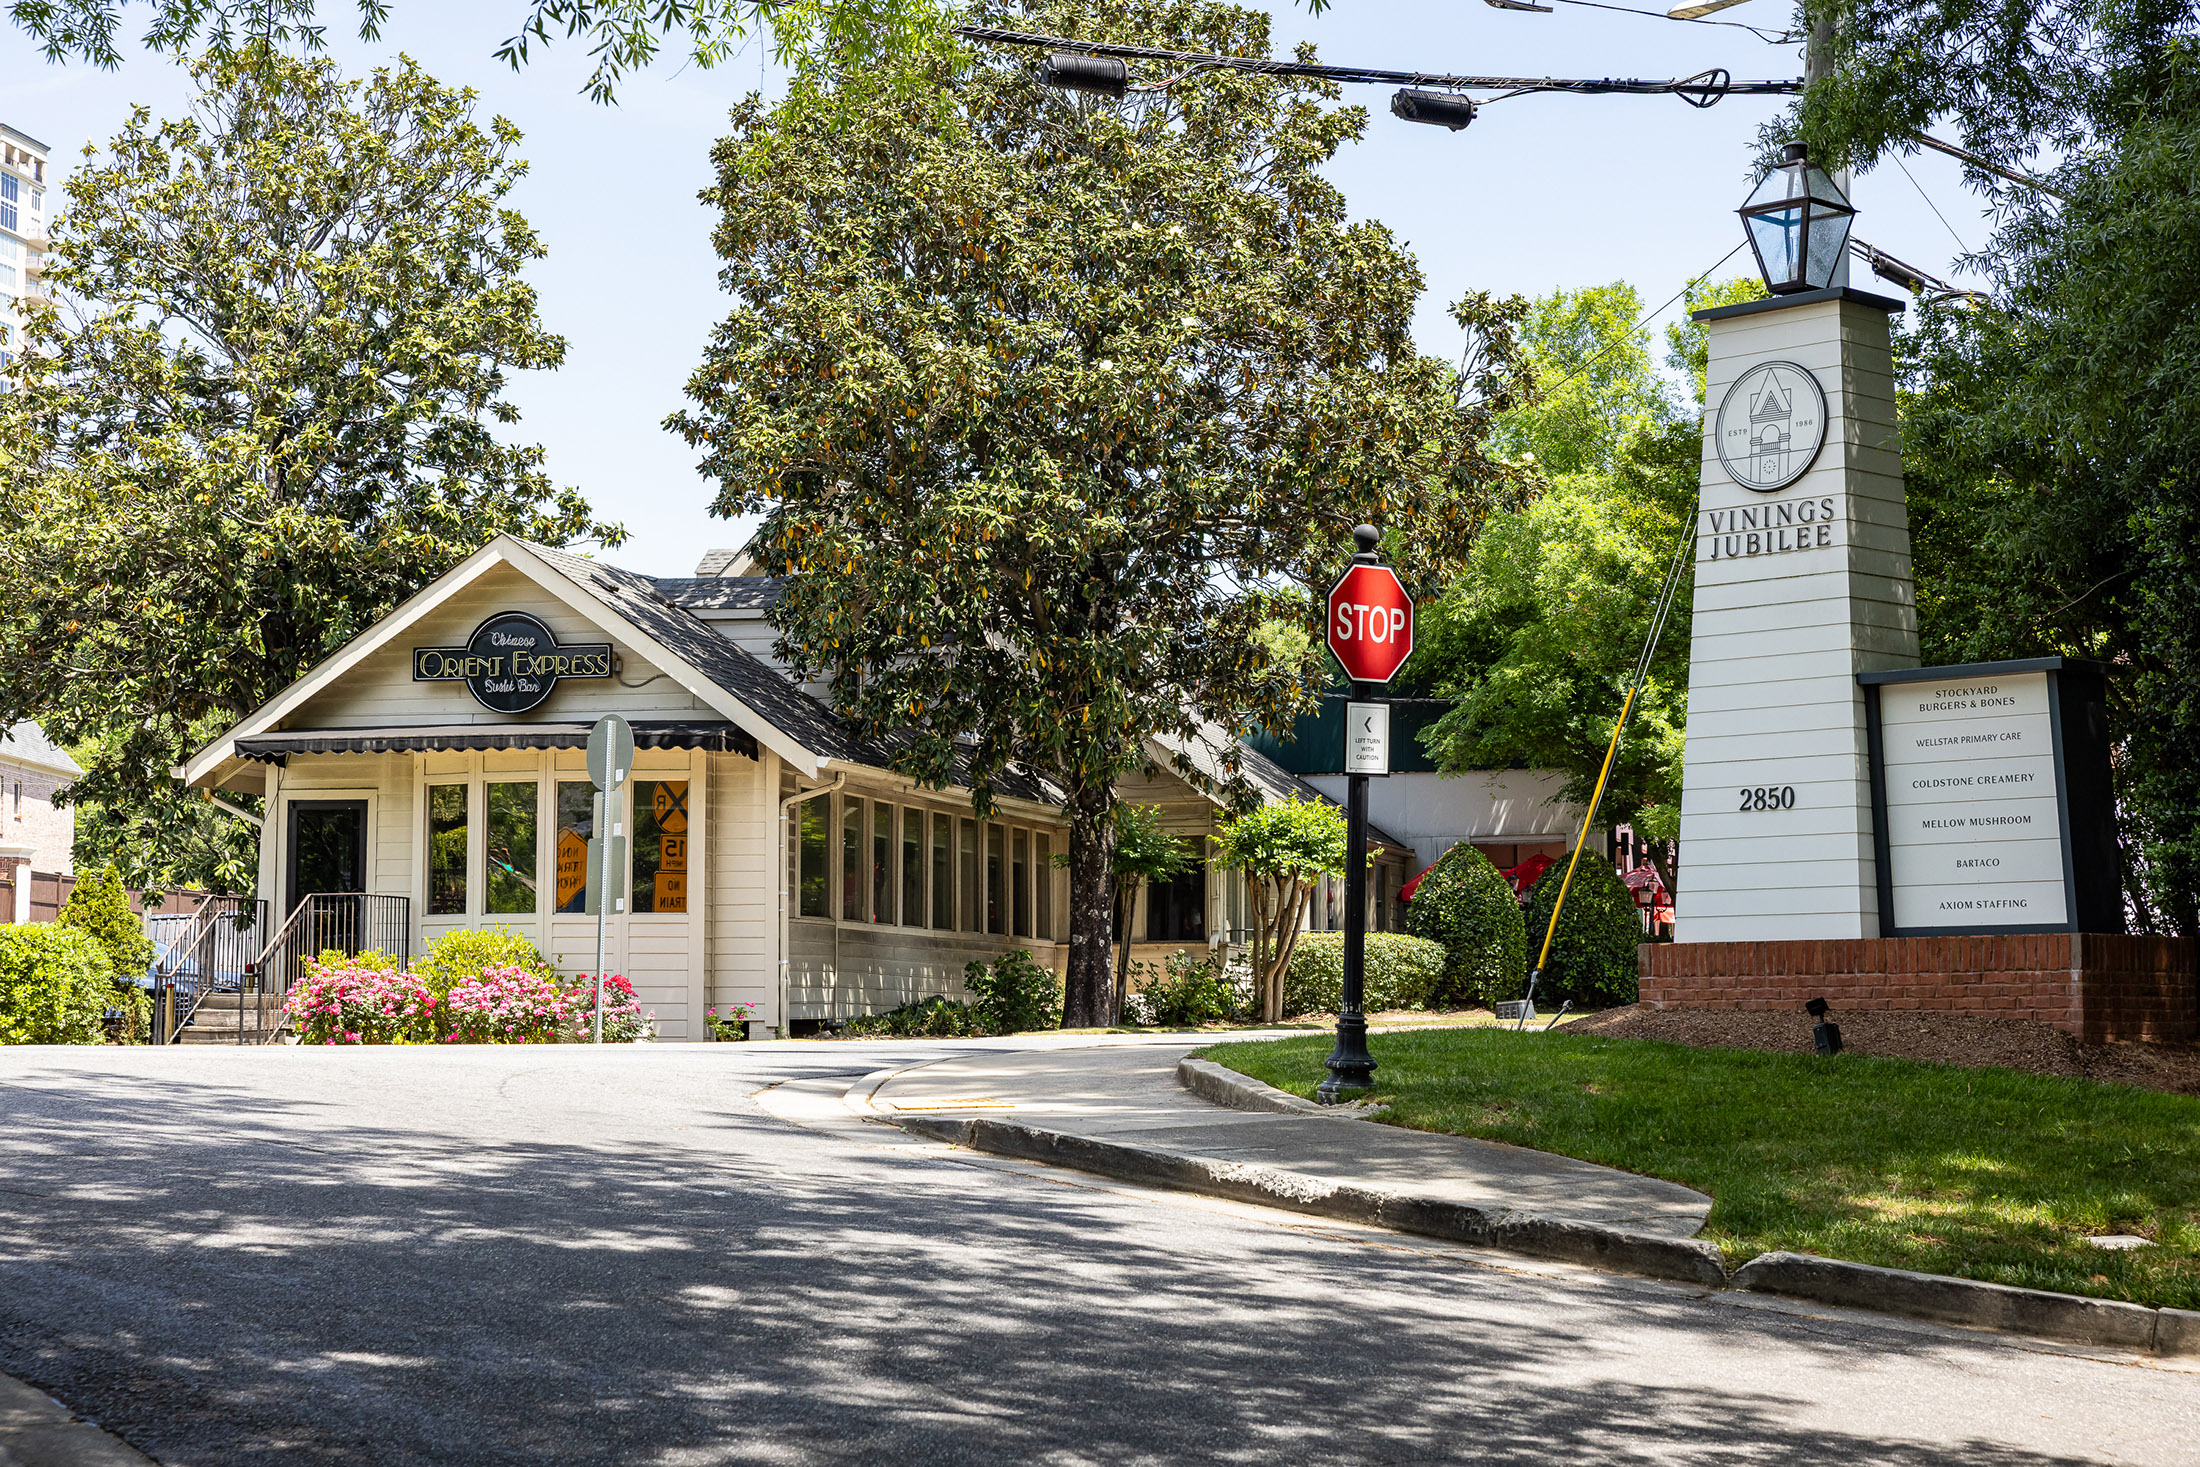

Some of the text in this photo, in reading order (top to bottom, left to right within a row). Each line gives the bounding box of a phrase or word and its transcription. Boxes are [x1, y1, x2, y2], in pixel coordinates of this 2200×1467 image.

[1795, 419, 1813, 427] 1986
[1709, 498, 1834, 533] VININGS
[1711, 525, 1831, 559] JUBILEE
[1337, 602, 1405, 643] STOP
[491, 632, 536, 647] Chinese
[484, 679, 541, 693] Sushi Bar
[1935, 685, 1998, 699] STOCKYARD
[1919, 697, 2015, 712] BURGERS & BONES
[1916, 732, 2022, 748] WELLSTAR PRIMARY CARE
[1912, 773, 2035, 788] COLDSTONE CREAMERY
[1739, 786, 1796, 811] 2850
[1922, 815, 2032, 829] MELLOW MUSHROOM
[1956, 858, 2000, 868] BARTACO
[1939, 899, 2027, 910] AXIOM STAFFING
